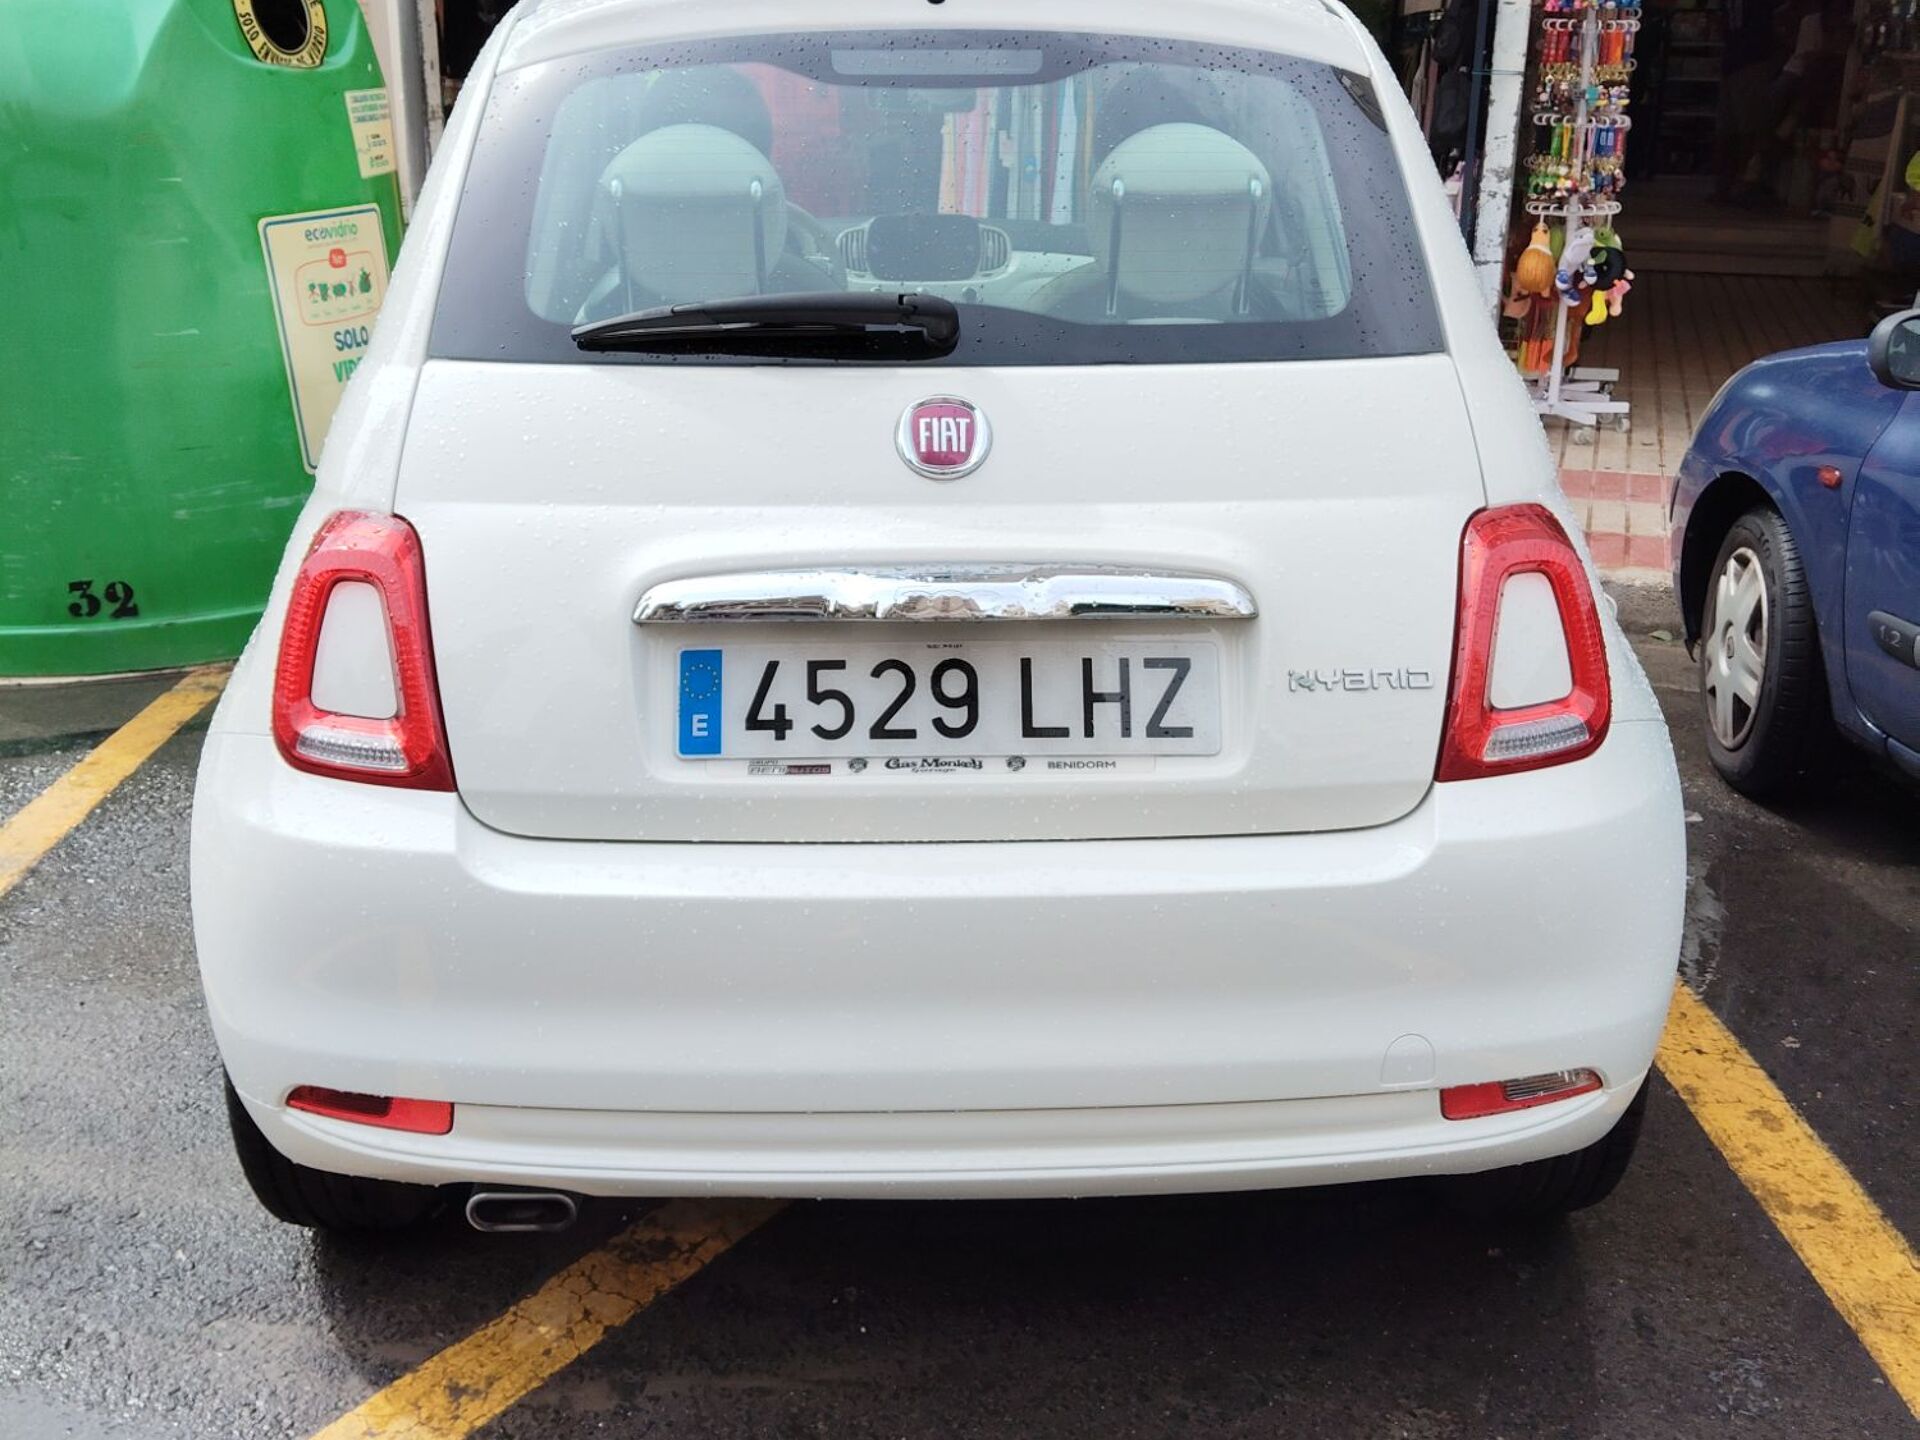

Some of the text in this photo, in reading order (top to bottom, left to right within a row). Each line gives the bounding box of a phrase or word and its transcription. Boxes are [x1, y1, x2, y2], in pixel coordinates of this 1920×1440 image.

[239, 12, 259, 41] SOLO
[305, 220, 358, 242] ecovidrio
[333, 325, 369, 352] SOLO
[332, 356, 363, 383] VID
[919, 417, 971, 453] FIAT
[67, 579, 140, 618] 32
[1287, 667, 1434, 692] HYBRID
[744, 656, 1194, 741] 4529 LHZ
[692, 714, 708, 737] E
[884, 756, 984, 771] Gas Monkey
[1047, 760, 1117, 770] BENIDORM
